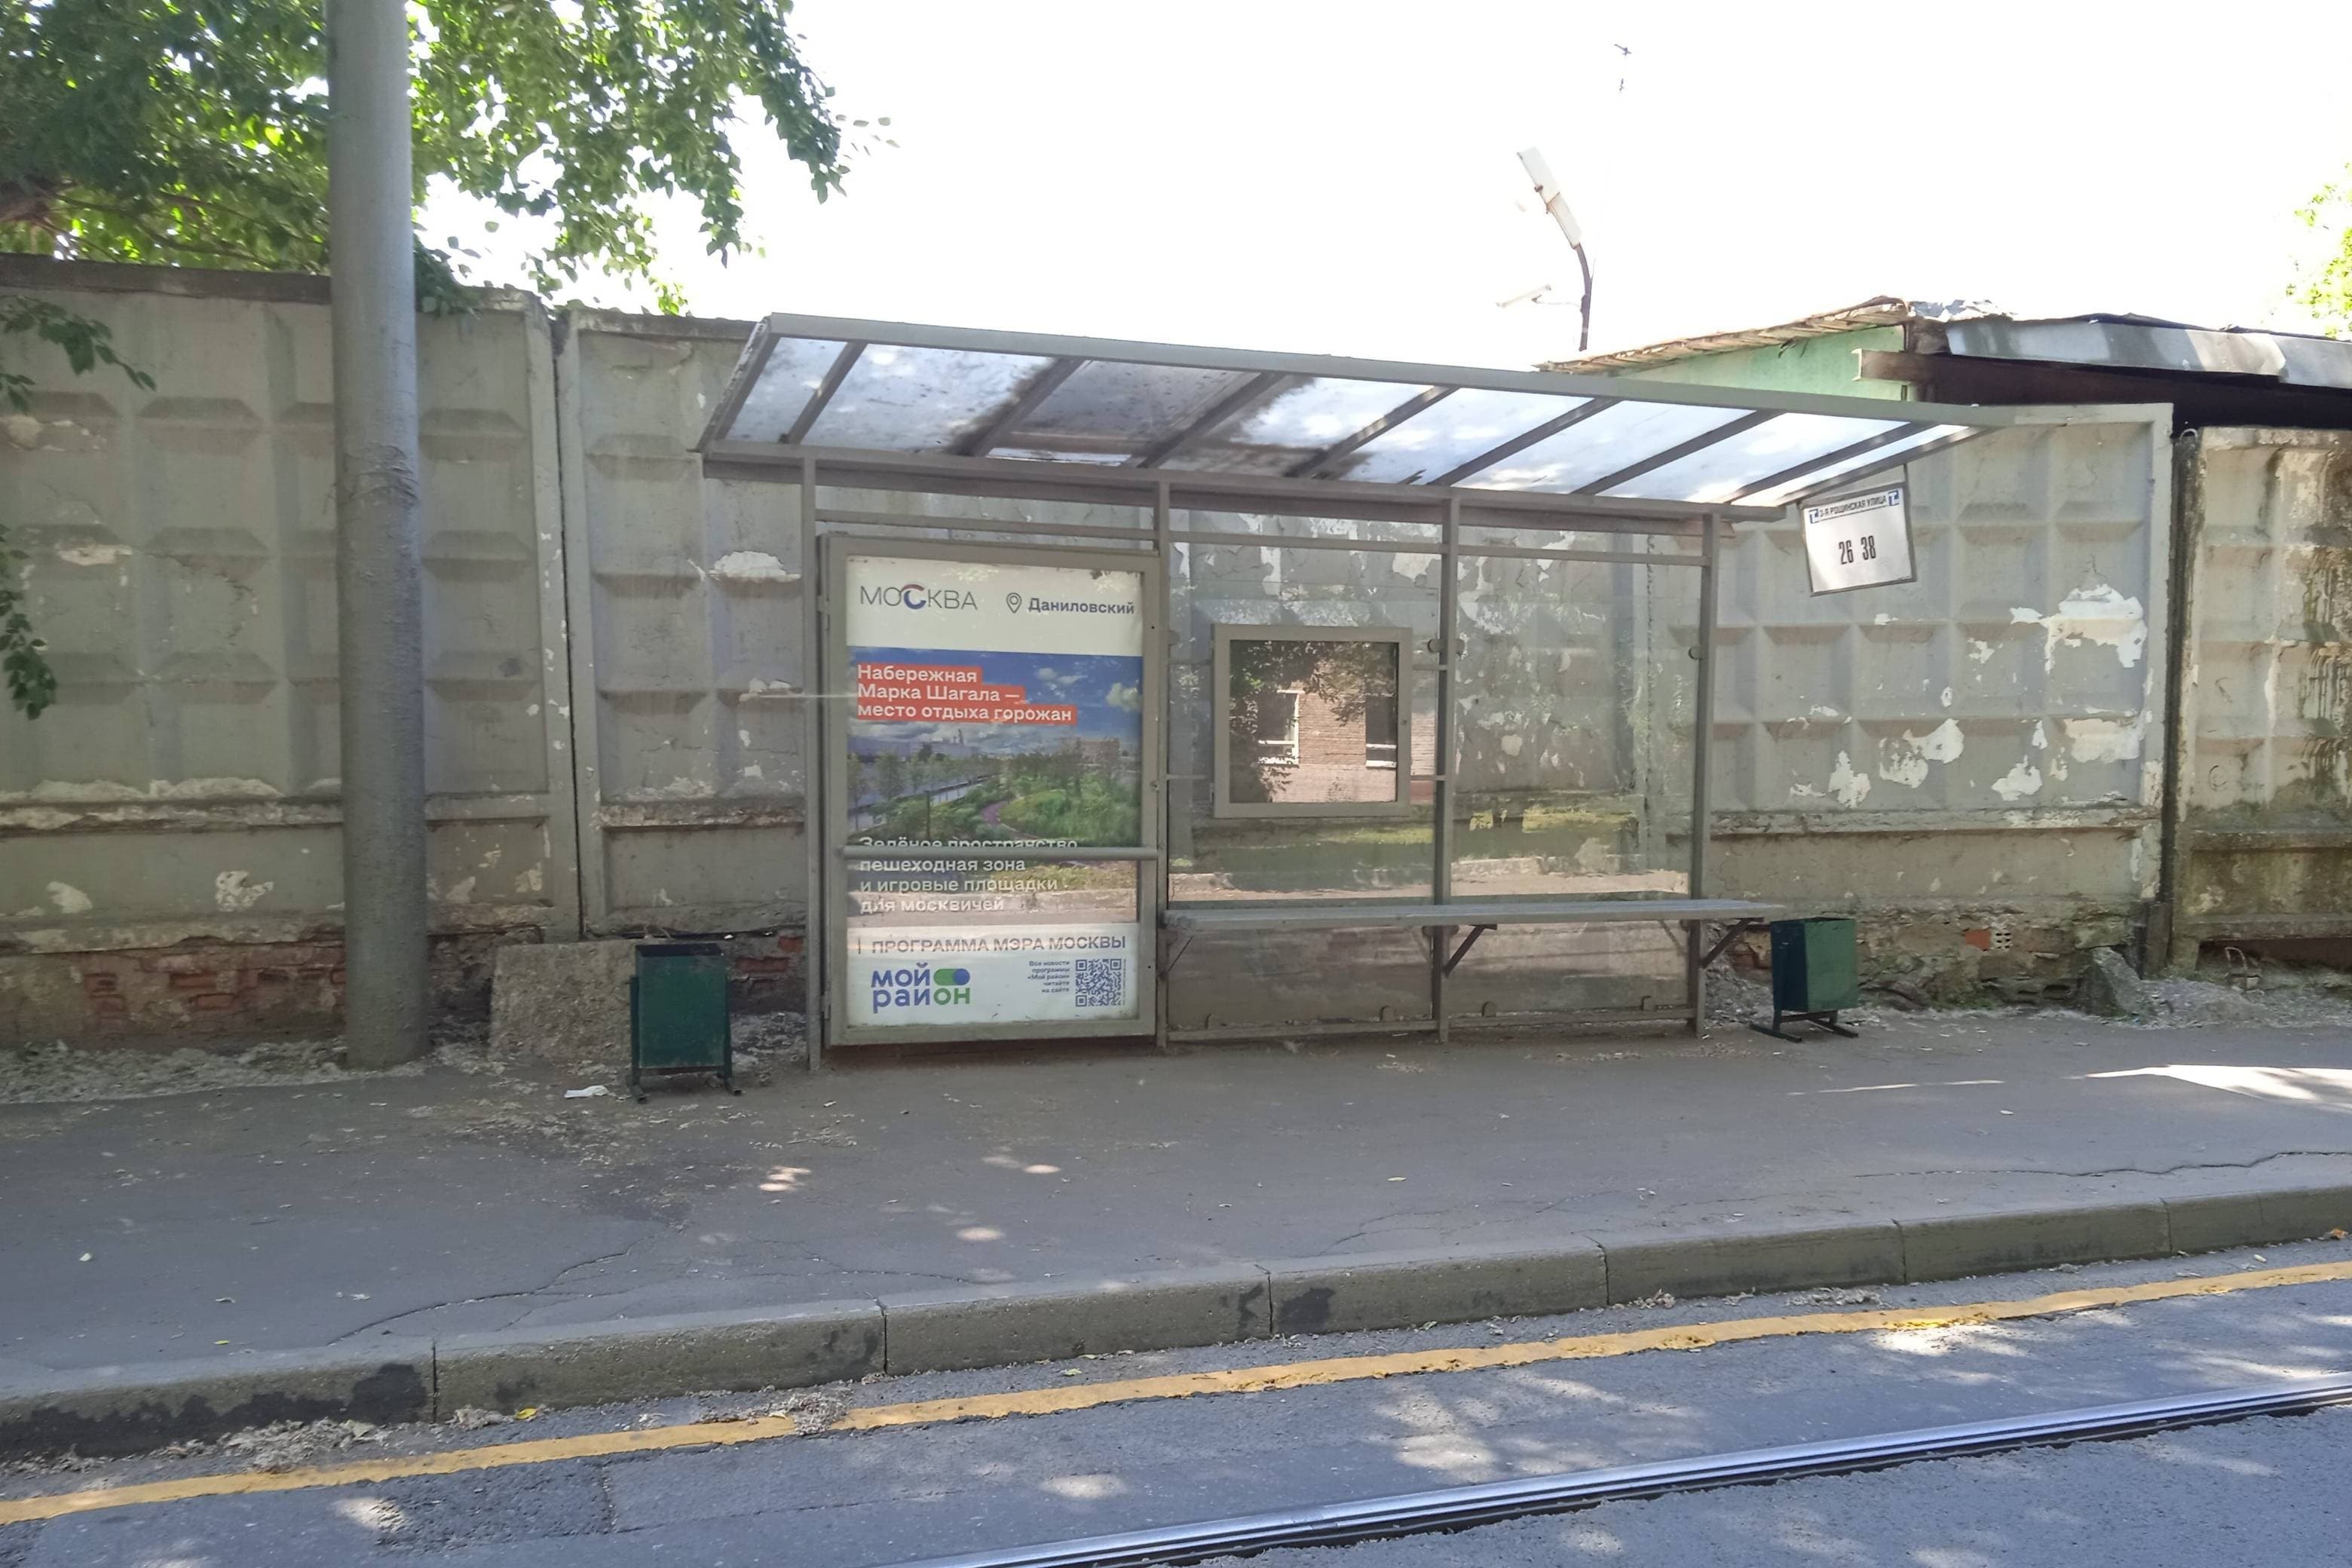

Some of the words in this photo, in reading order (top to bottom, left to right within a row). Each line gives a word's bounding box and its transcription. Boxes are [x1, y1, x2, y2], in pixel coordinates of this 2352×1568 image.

[1867, 495, 1887, 507] УЛИЦА
[1838, 540, 1854, 565] 26
[1860, 535, 1877, 560] 38
[859, 582, 978, 611] МОСКВА
[1027, 597, 1135, 615] Даниловский
[858, 665, 978, 684] Набережная
[858, 683, 922, 701] Марка
[926, 685, 1000, 702] Шагала
[858, 705, 917, 718] место
[921, 706, 990, 720] отдыха
[994, 708, 1072, 724] горожан
[859, 859, 978, 873] пешеходная
[983, 859, 1026, 871] зона
[860, 880, 871, 892] и
[877, 880, 960, 894] игровые
[963, 879, 1058, 893] площадки
[860, 900, 896, 914] для
[901, 896, 1005, 912] москвичей
[871, 939, 990, 954] ПРОГРАММА
[994, 937, 1045, 951] МЭРА
[1049, 936, 1126, 951] МОСКВЫ
